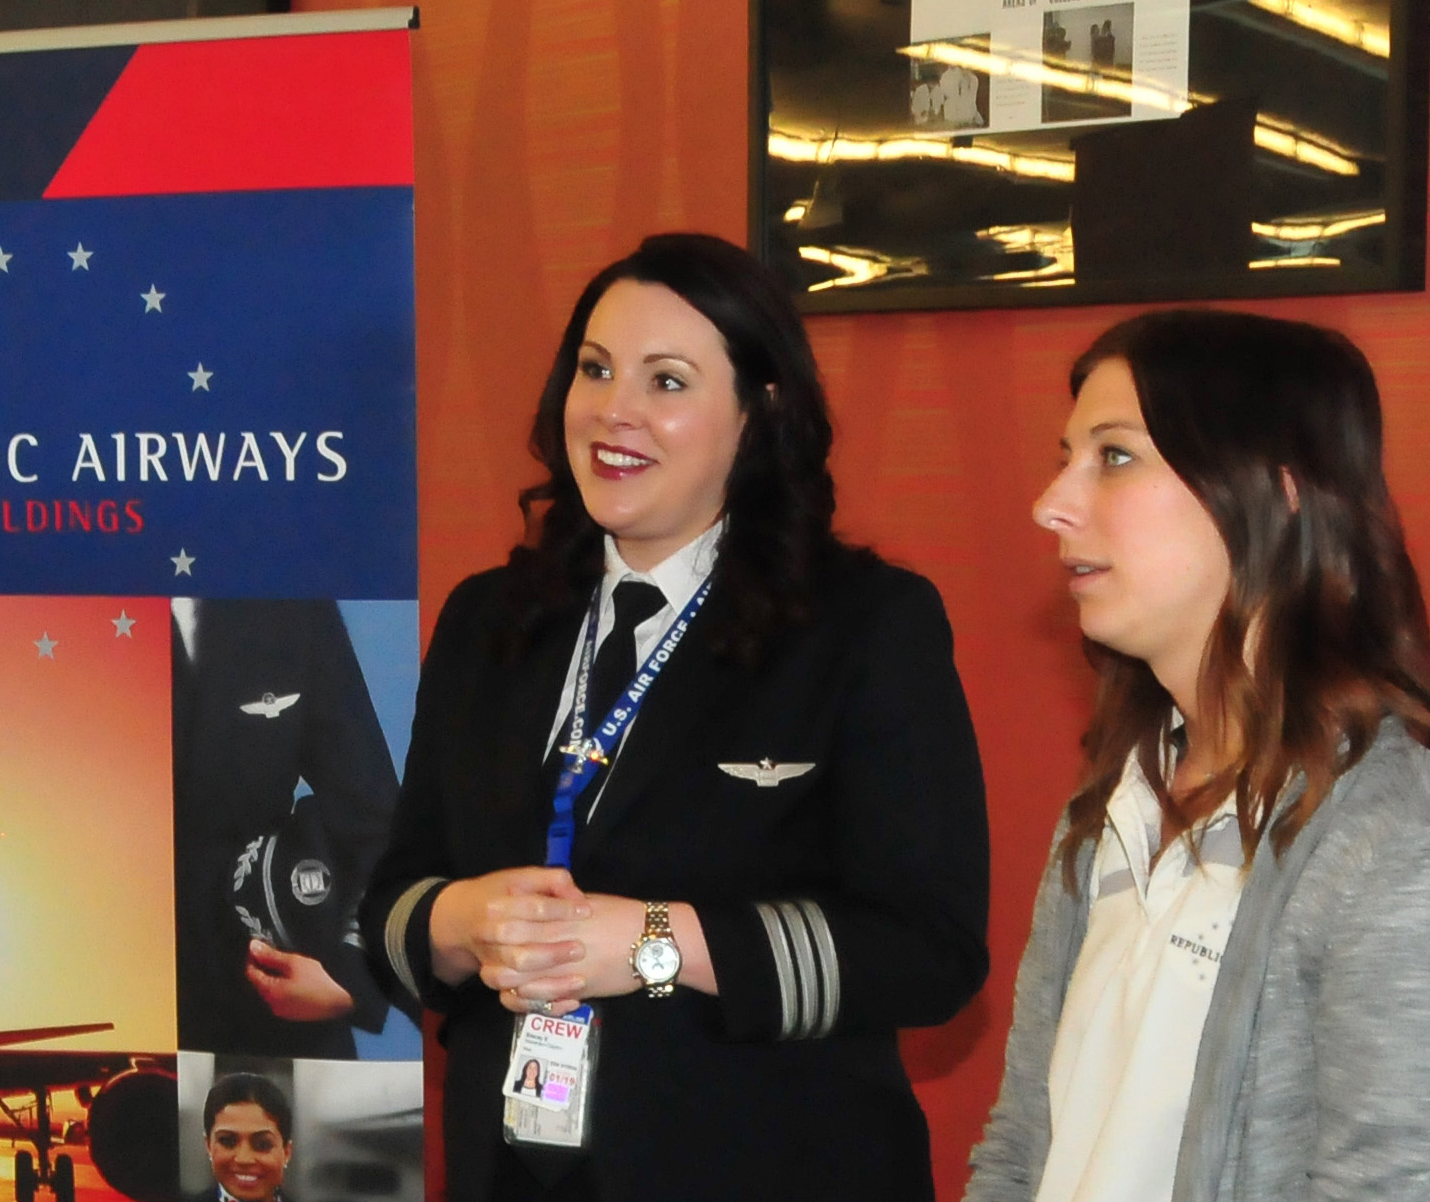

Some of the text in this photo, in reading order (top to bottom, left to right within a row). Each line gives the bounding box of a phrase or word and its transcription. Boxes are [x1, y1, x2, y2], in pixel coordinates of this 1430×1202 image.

[71, 429, 349, 483] AIRWAYS
[602, 619, 688, 737] U.S. AIR FORCE
[530, 1016, 583, 1039] CREW
